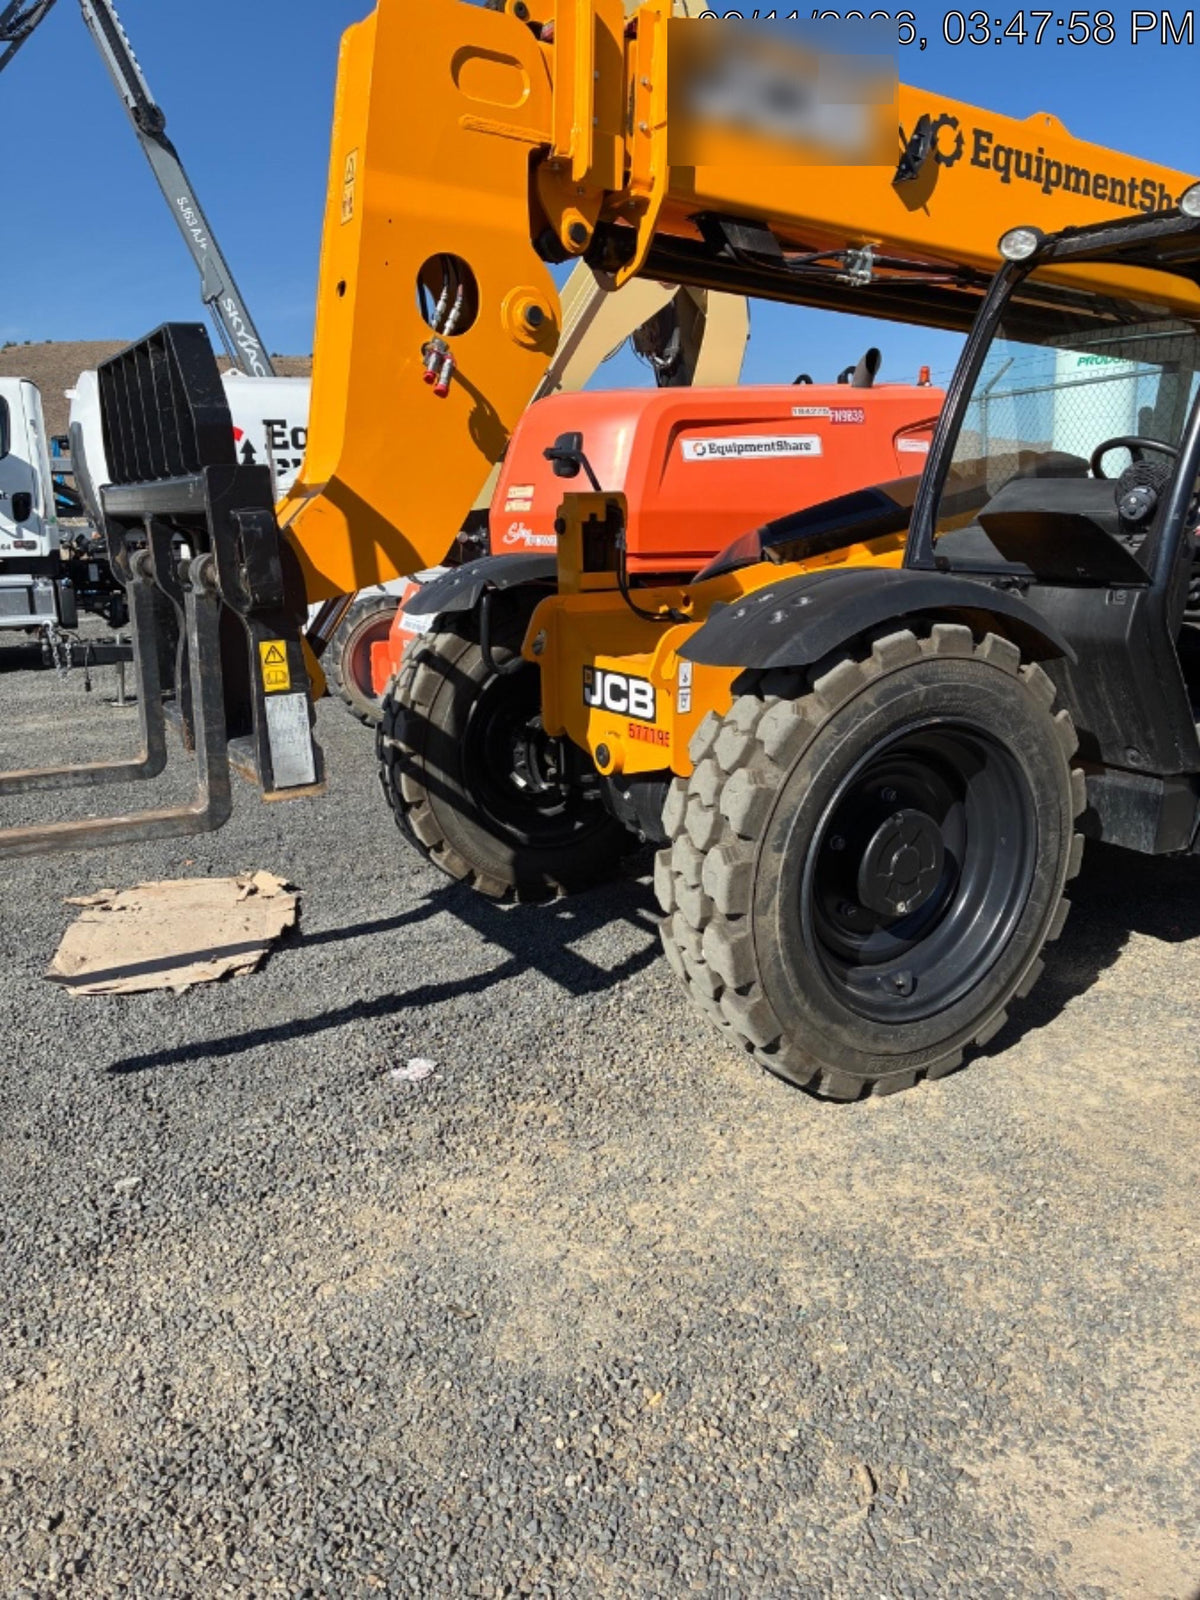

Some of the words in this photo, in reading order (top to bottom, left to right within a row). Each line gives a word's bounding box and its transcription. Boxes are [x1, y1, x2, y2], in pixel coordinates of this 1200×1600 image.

[970, 127, 1182, 215] EquipmentSh
[707, 440, 812, 456] EquipmentShare
[584, 670, 656, 720] JCB
